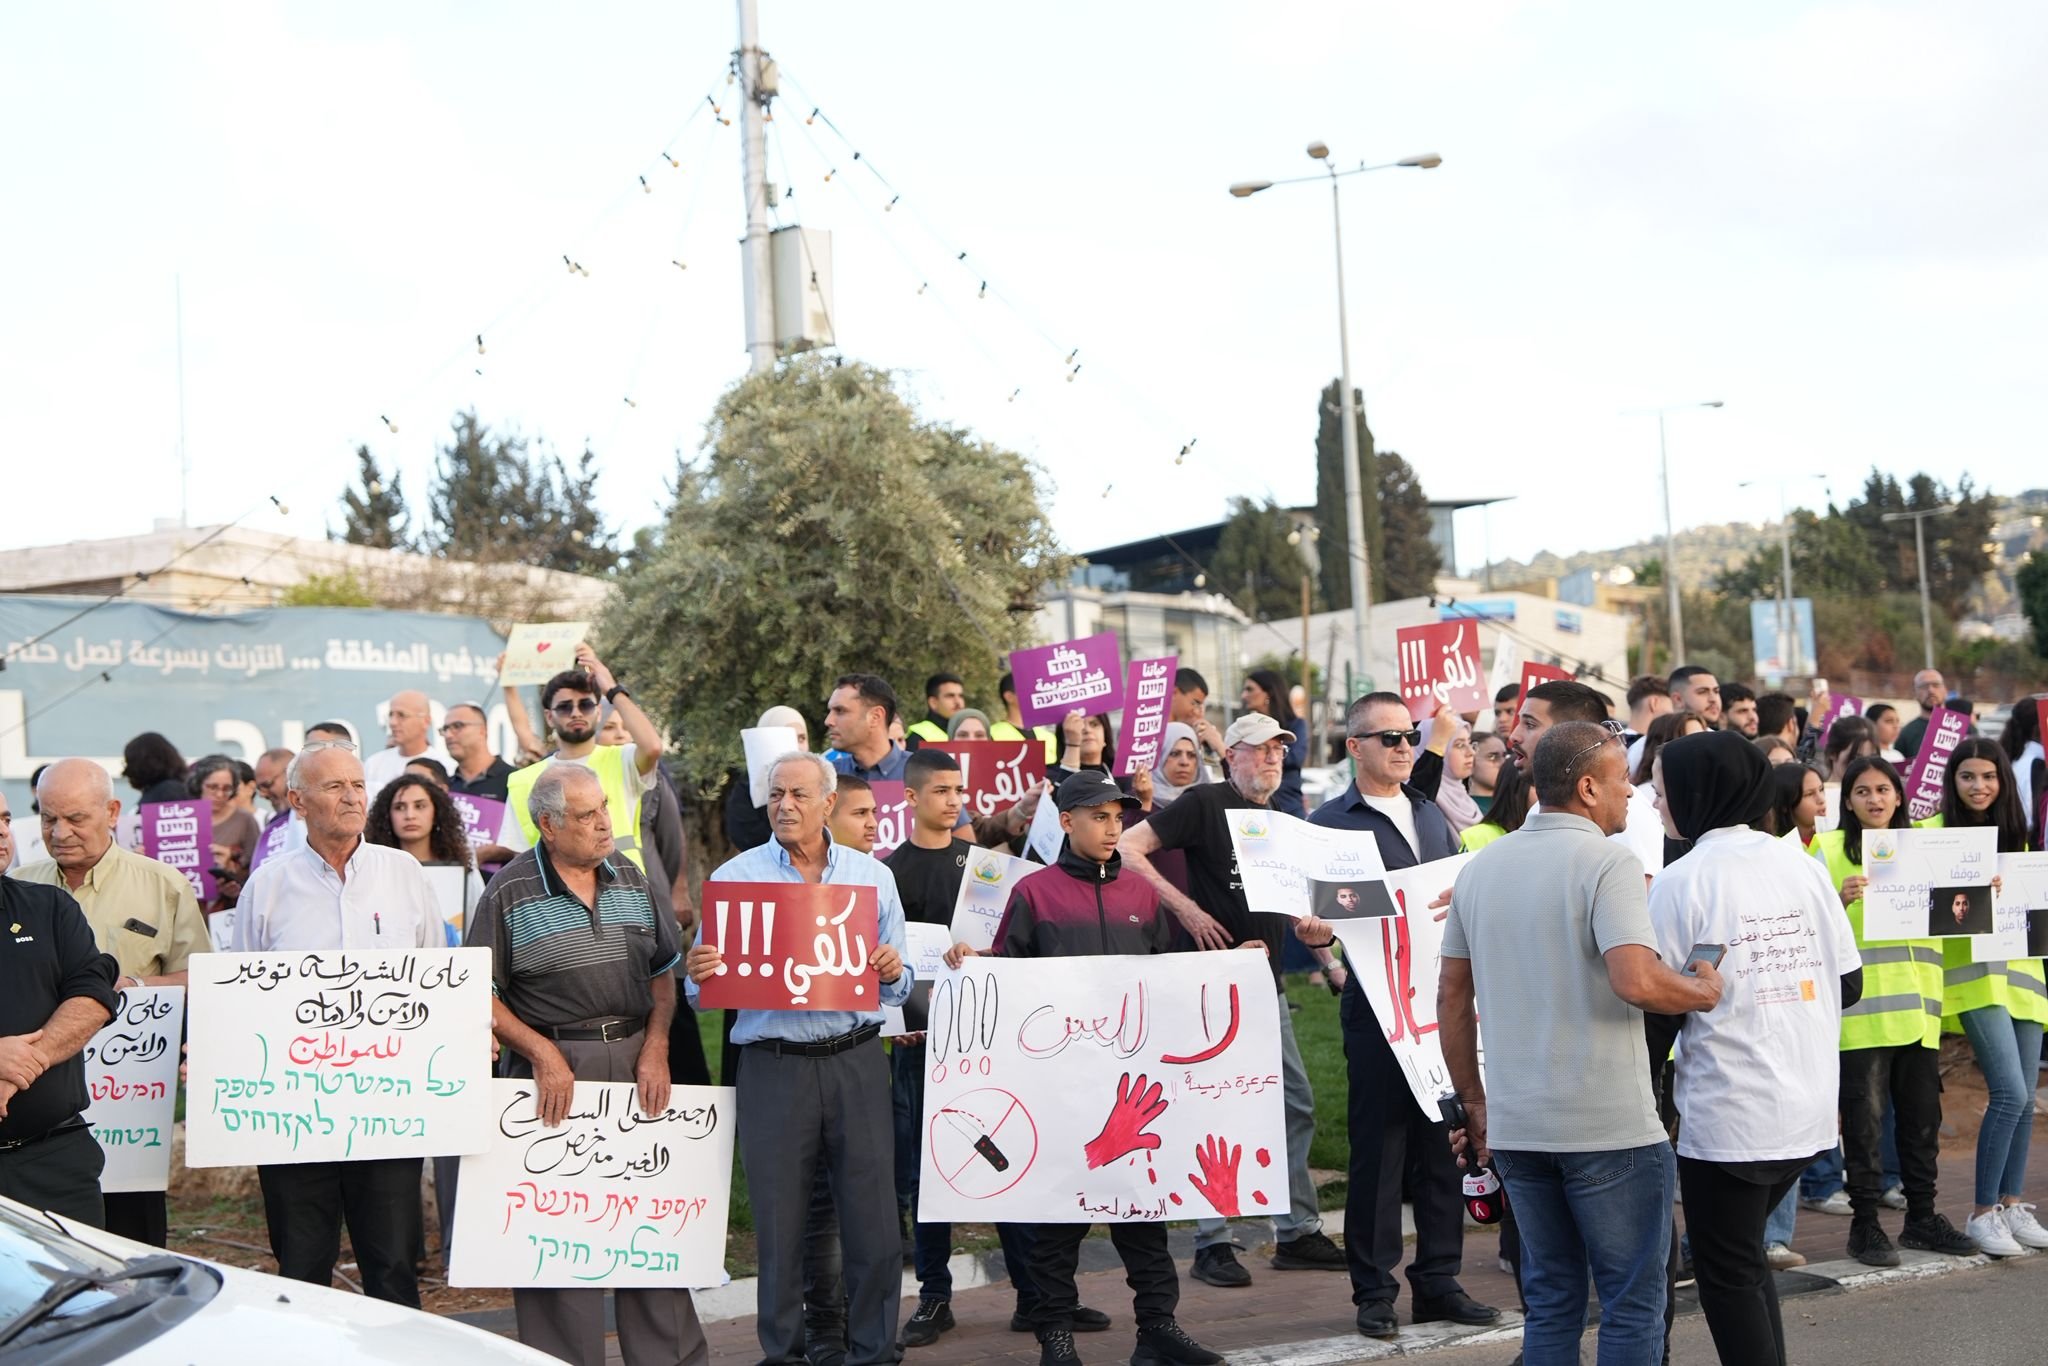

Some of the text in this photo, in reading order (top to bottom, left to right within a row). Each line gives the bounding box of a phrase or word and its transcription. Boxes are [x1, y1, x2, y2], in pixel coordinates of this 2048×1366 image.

[65, 636, 123, 672] تصل
[128, 639, 210, 676] بسرعة
[325, 639, 430, 674] المنطقة
[432, 645, 473, 683] في
[1052, 658, 1082, 672] ביחד
[1035, 668, 1105, 692] ضد الجريمة
[1036, 682, 1108, 706] נגד הפשיעה
[1138, 720, 1159, 733] אינם
[1873, 883, 1906, 893] محمد
[213, 954, 471, 992] على الشرطة توفير
[127, 993, 173, 1025] على
[1160, 982, 1241, 1065] لا
[288, 1031, 402, 1072] للمواطن
[91, 1075, 166, 1102] המשט
[212, 1032, 467, 1114] על המשטרה לספק
[1184, 1071, 1232, 1100] حزينة
[1235, 1075, 1280, 1095] عرعرة
[219, 1098, 426, 1158] בטחון לאזרחים
[523, 1126, 670, 1181] الغير مرخص
[502, 1181, 589, 1235] הנשק
[584, 1193, 639, 1232] את
[1076, 1191, 1118, 1219] لعبة
[527, 1224, 680, 1281] הבלתי חוקי
